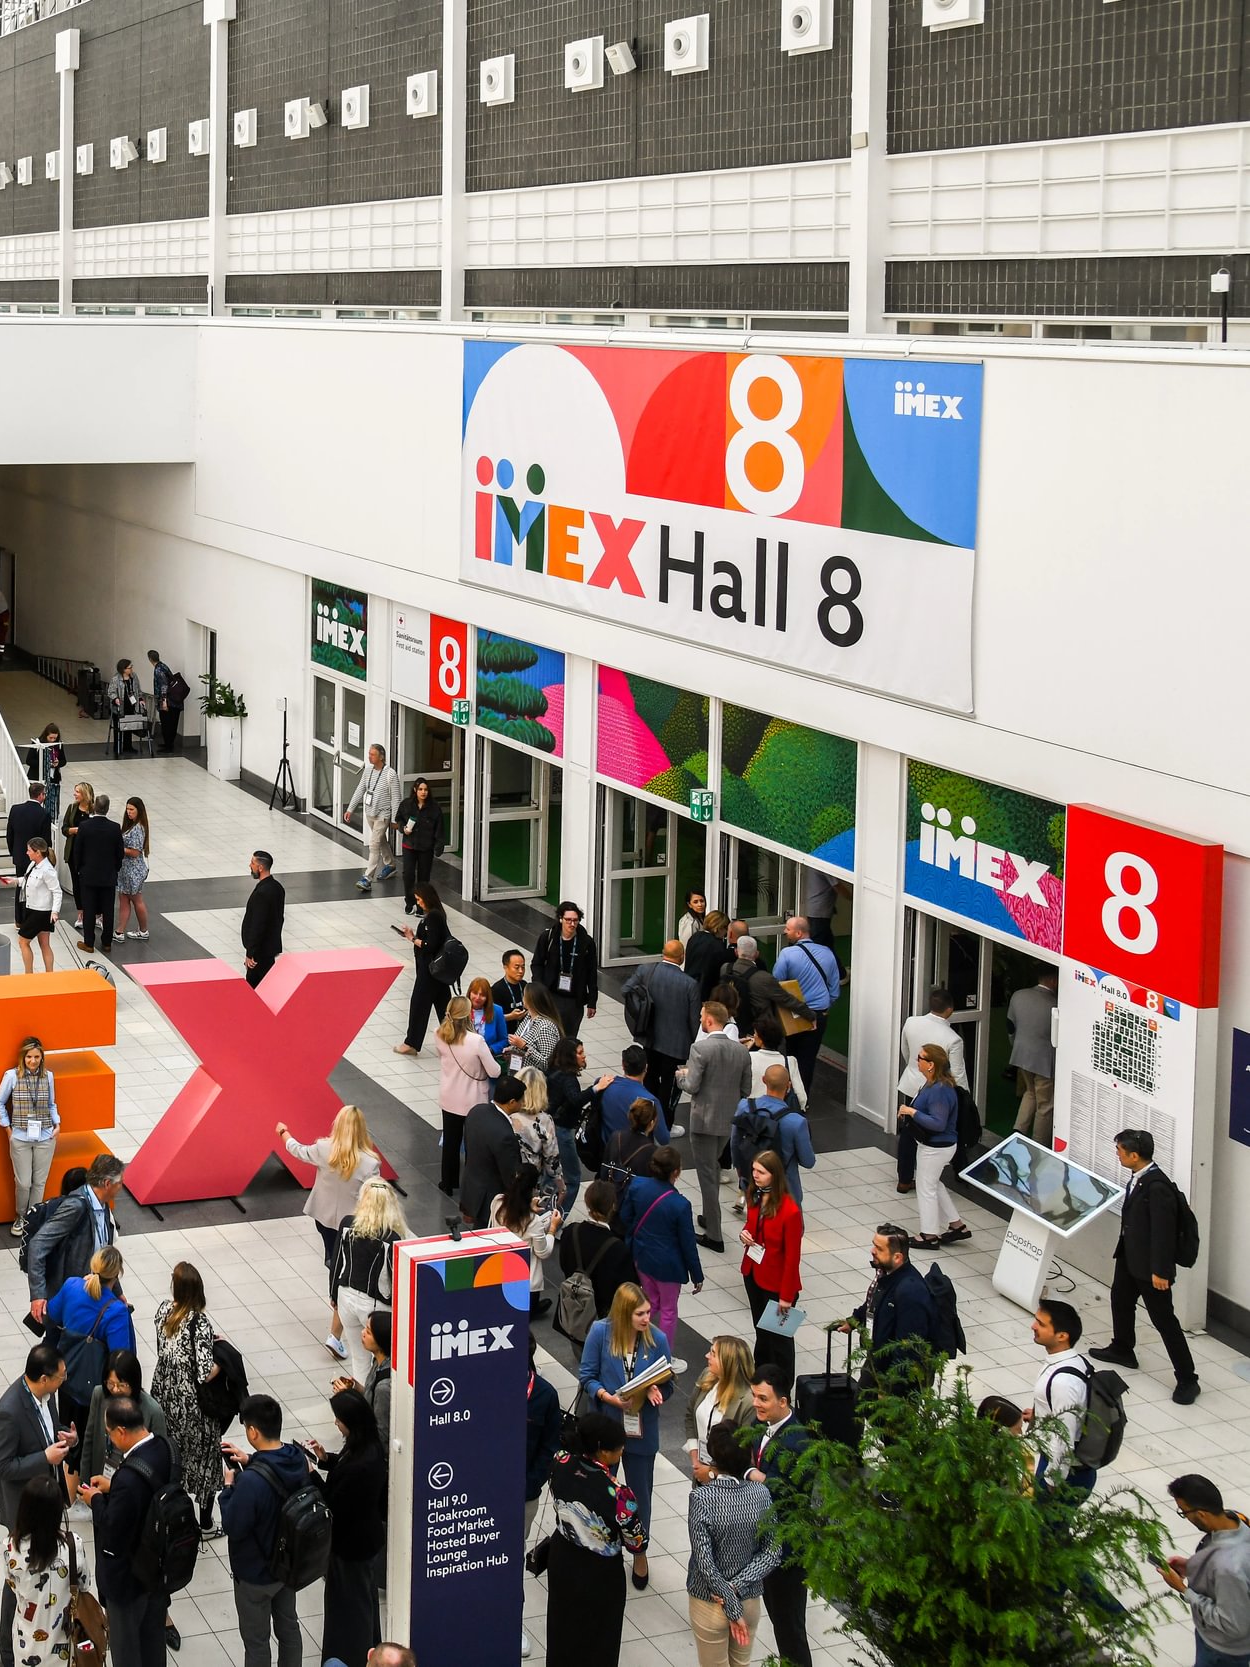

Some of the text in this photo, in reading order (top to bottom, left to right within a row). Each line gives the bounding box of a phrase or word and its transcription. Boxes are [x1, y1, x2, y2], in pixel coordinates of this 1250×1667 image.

[725, 354, 804, 517] 8
[658, 524, 789, 633] Hall
[817, 555, 865, 648] 8
[438, 635, 461, 697] 8
[1101, 851, 1159, 955] 8
[1101, 984, 1128, 1000] Hall 8.0
[1146, 990, 1159, 1012] 8
[429, 1409, 471, 1427] Hall 8.0
[428, 1493, 468, 1510] Hall 9.0
[427, 1506, 487, 1524] Cloakroom
[427, 1517, 495, 1538] Food Market
[427, 1530, 500, 1552] Hosted Buyer
[426, 1549, 468, 1565] Lounge
[426, 1553, 509, 1578] Inspiration Hub
